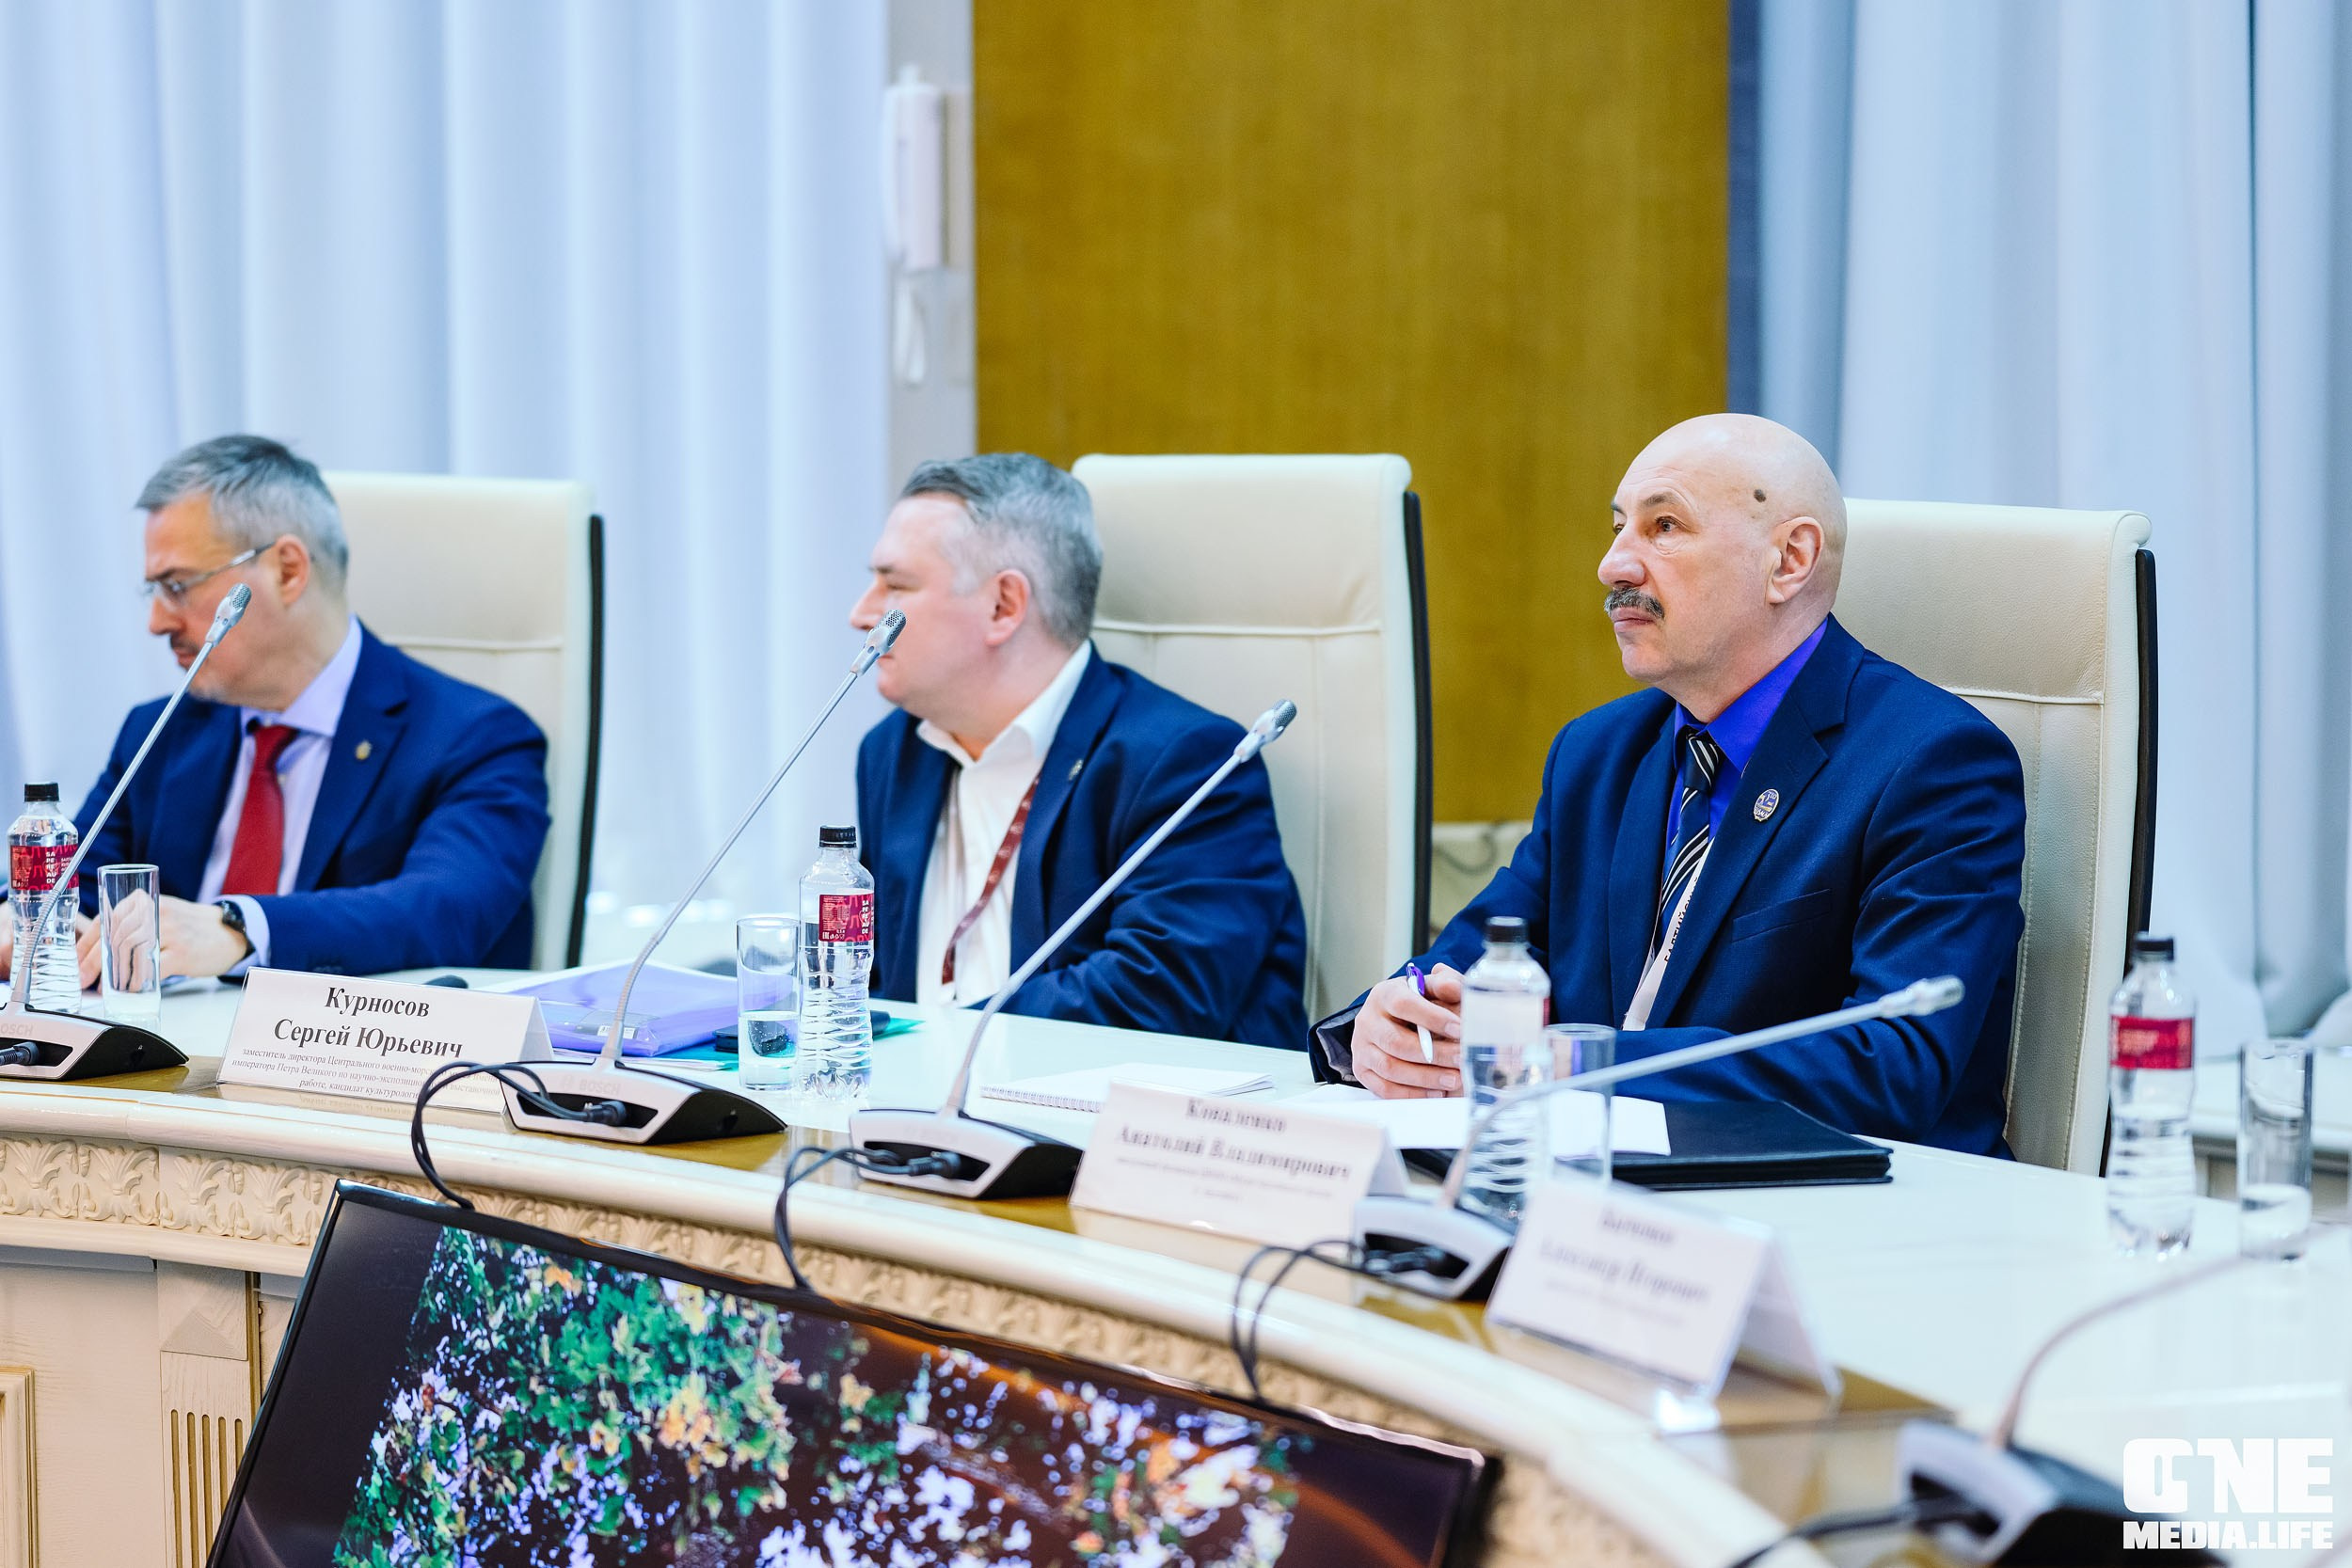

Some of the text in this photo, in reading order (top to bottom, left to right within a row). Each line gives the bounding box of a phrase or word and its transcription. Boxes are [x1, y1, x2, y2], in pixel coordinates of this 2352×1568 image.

[325, 987, 430, 1018] Курносов
[274, 1018, 463, 1058] Сергей Юрьевич
[231, 1059, 276, 1071] императора
[277, 1063, 300, 1076] Петра
[301, 1065, 337, 1079] Великого
[243, 1048, 286, 1060] заместитель
[287, 1053, 326, 1065] директора
[327, 1055, 381, 1069] Центрального
[298, 1078, 420, 1099] работе, кандидат культурологи
[579, 1079, 622, 1096] BOSCH
